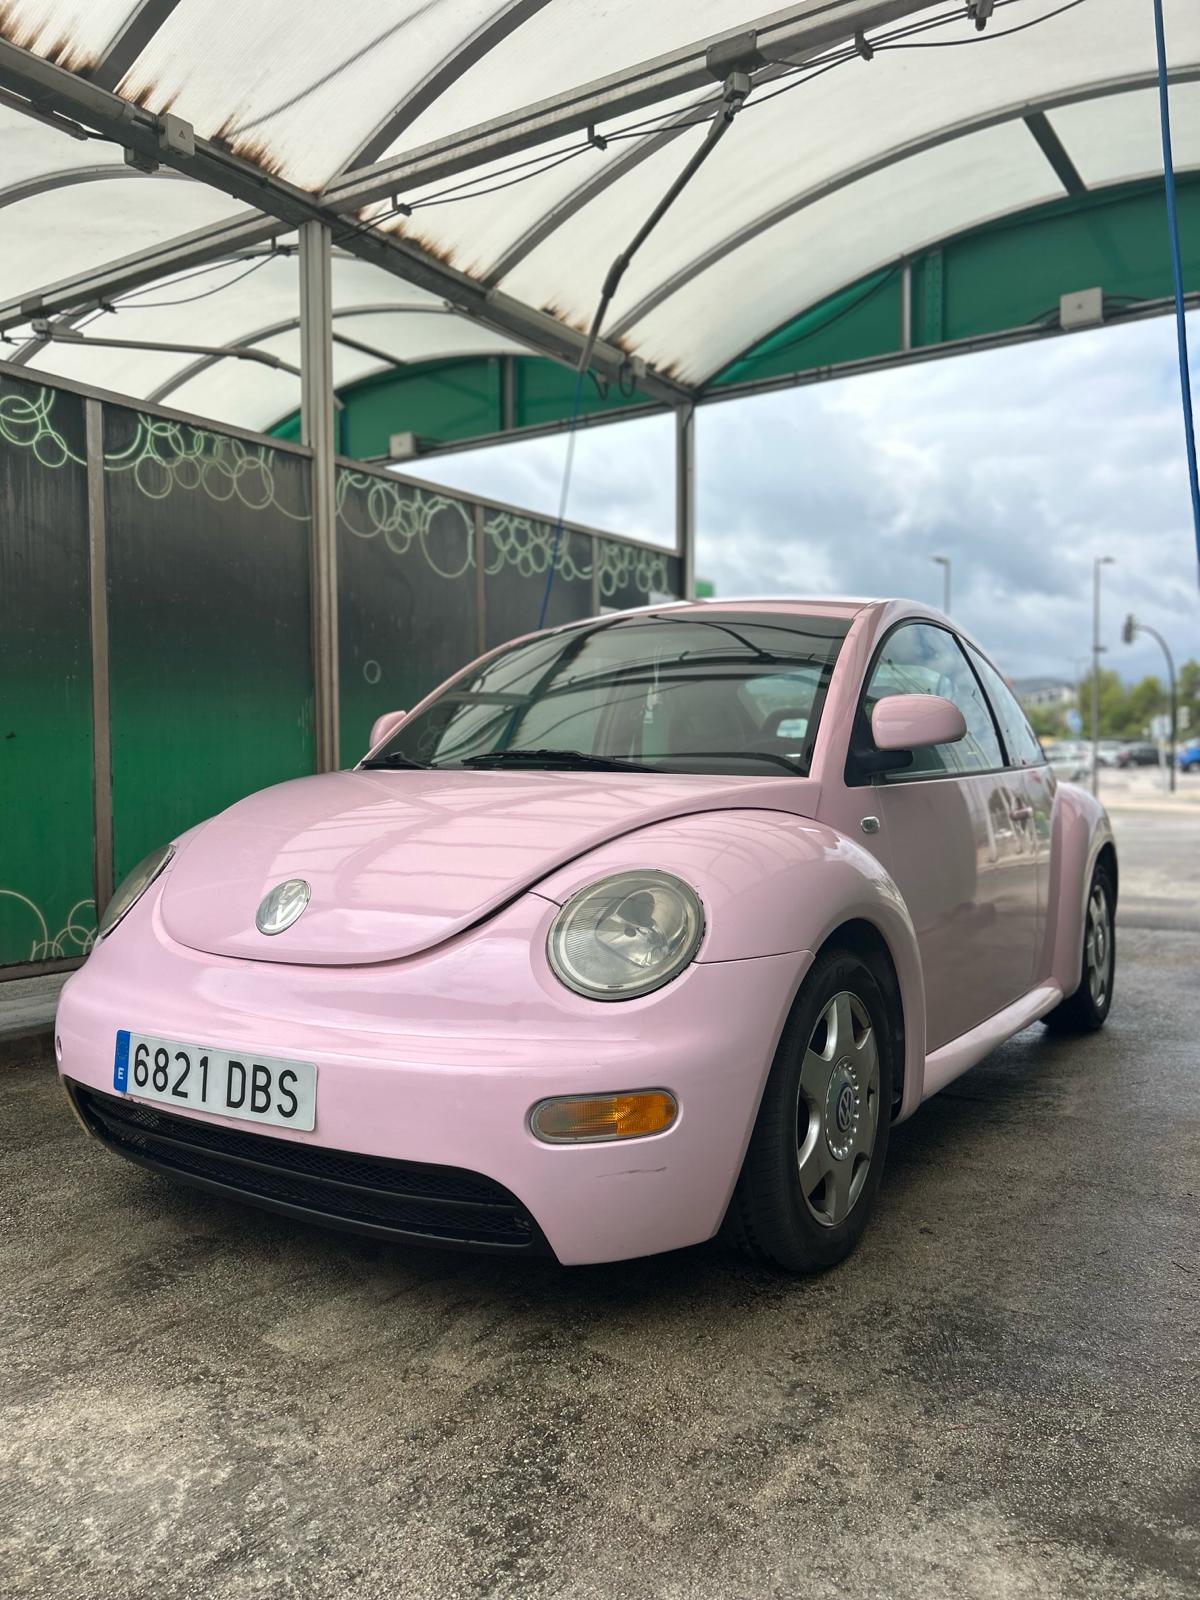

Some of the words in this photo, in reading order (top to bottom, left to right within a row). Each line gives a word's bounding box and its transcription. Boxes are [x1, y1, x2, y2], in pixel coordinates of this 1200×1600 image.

[117, 1067, 125, 1080] E
[133, 1043, 209, 1103] 6821
[226, 1060, 298, 1118] DBS
